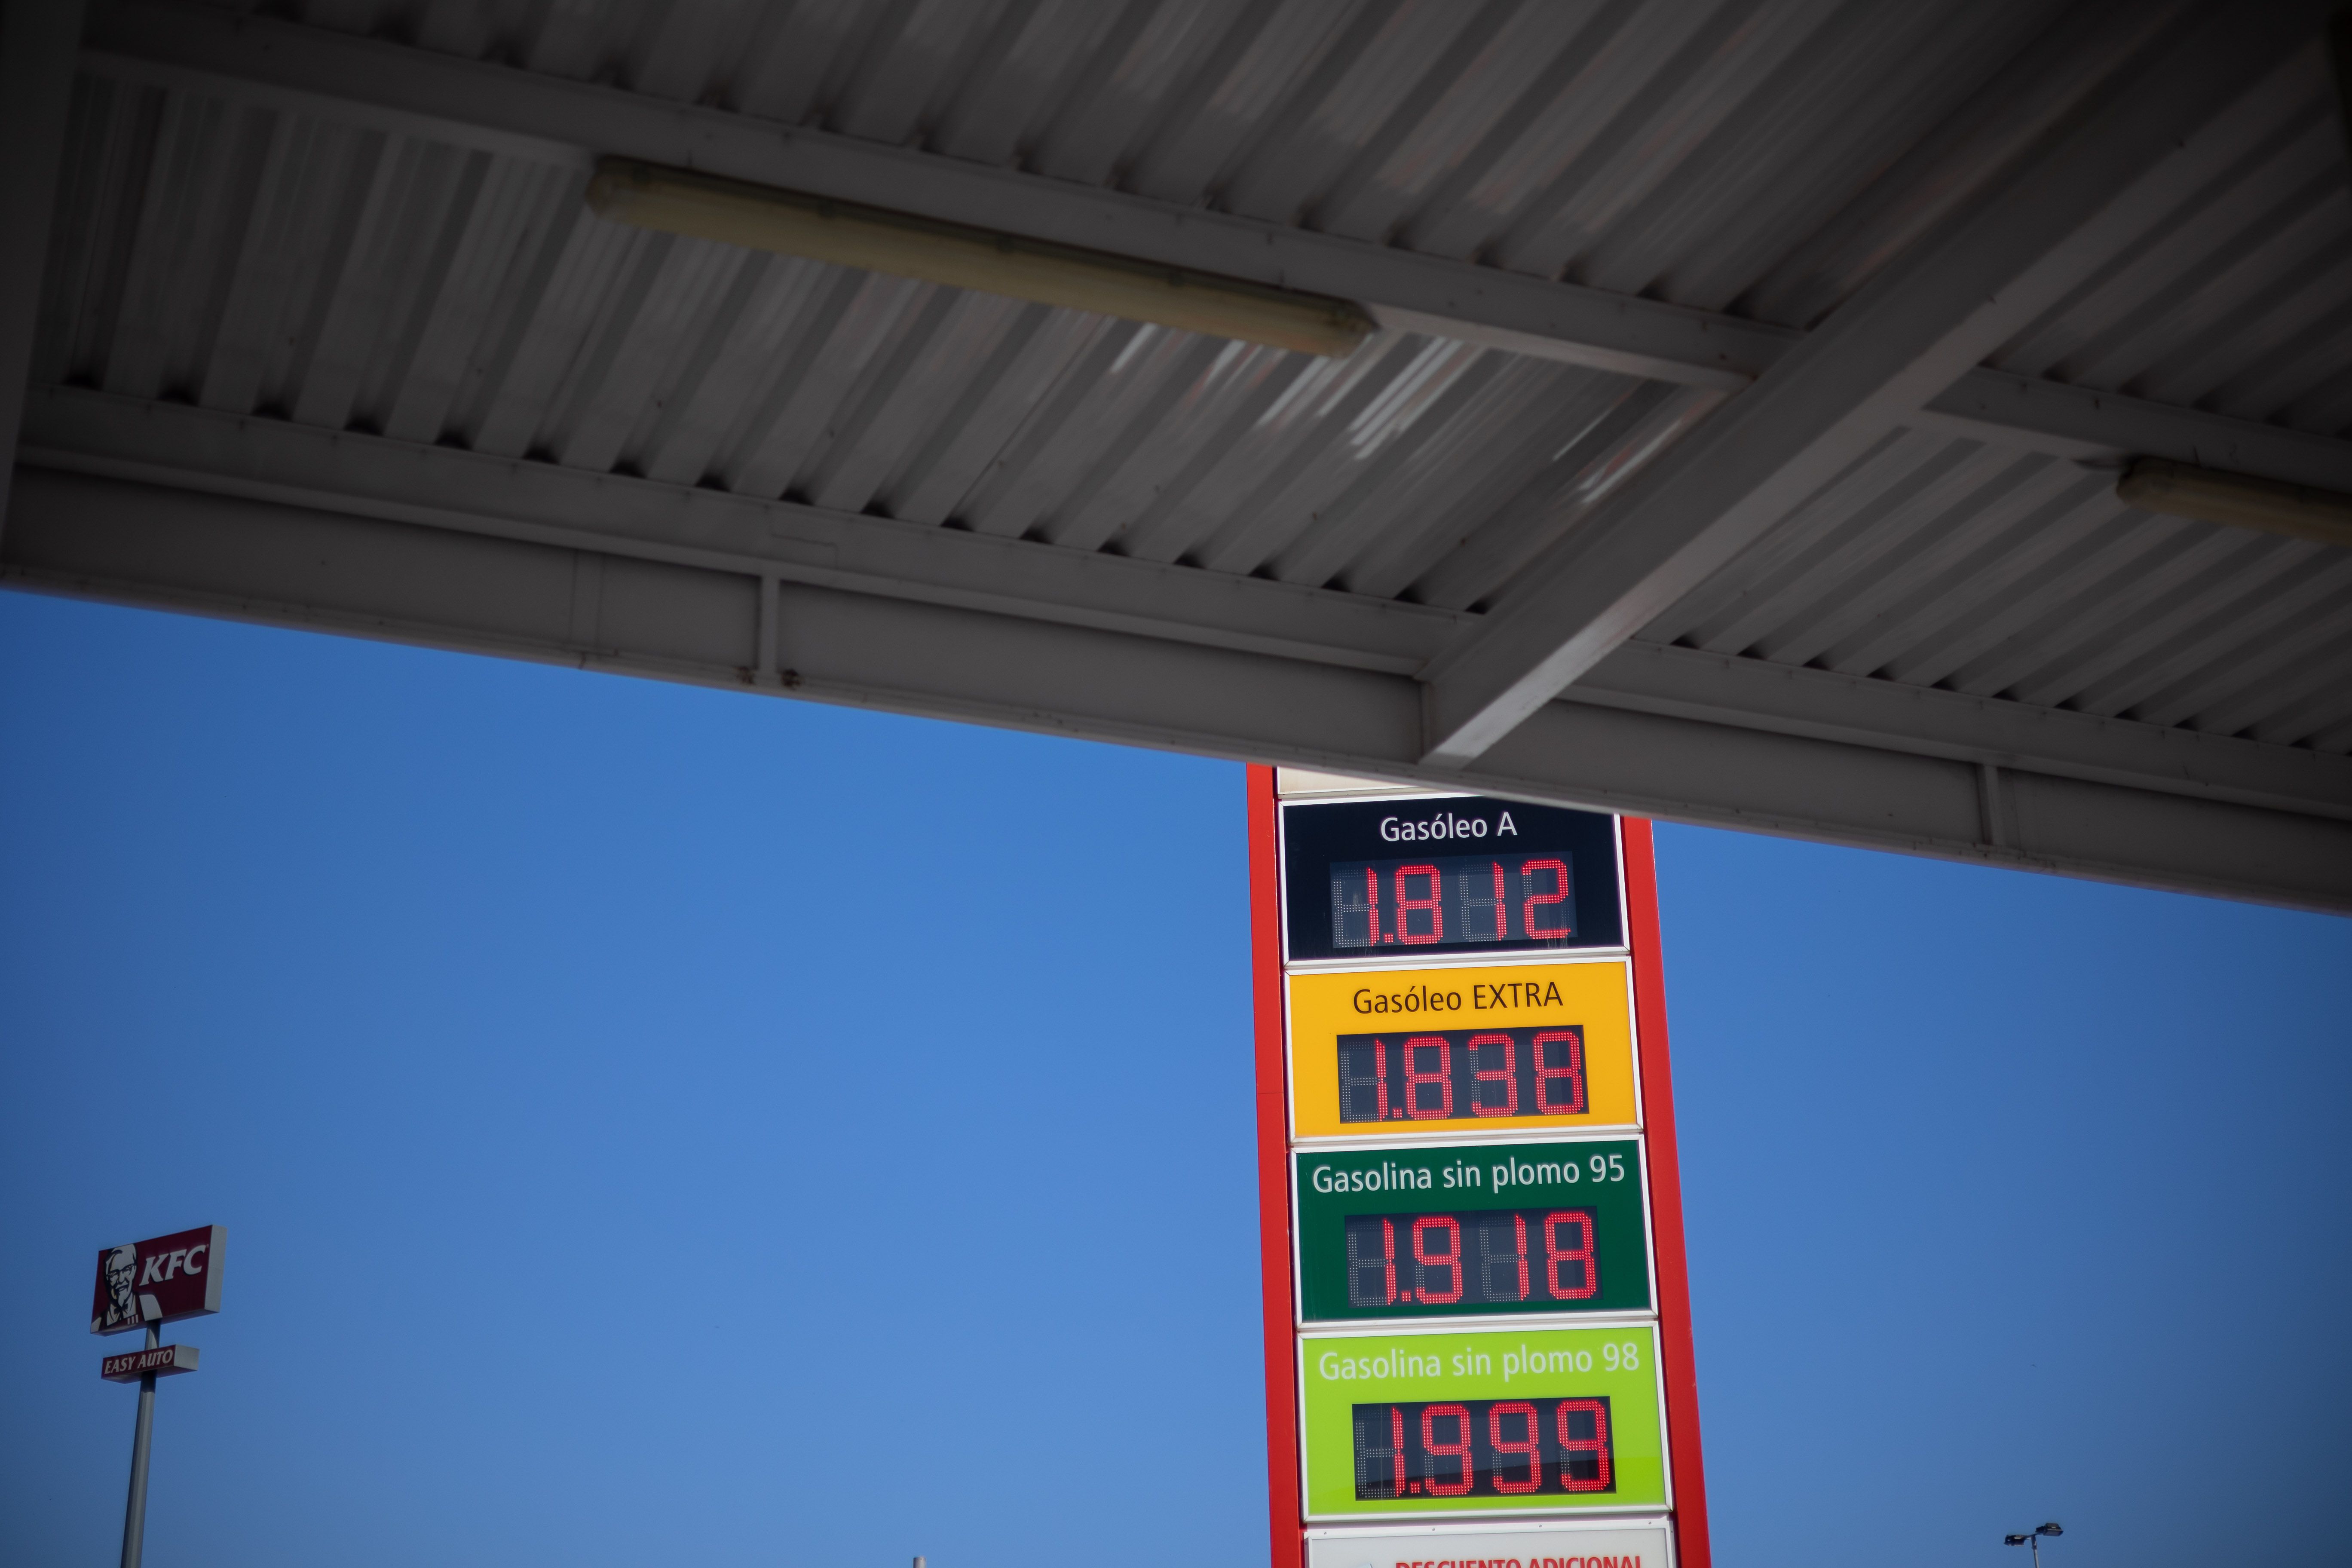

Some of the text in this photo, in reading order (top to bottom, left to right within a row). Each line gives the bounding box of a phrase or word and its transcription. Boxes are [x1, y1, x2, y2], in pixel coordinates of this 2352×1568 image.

[1381, 812, 1518, 842] Gasóleo A
[1367, 859, 1571, 946] 1.812
[1354, 982, 1563, 1014] Gasóleo EXTRA
[1375, 1031, 1583, 1122] 1.838
[1313, 1155, 1625, 1194] Gasolina sin plomo 95
[139, 1245, 206, 1286] KFC
[1384, 1212, 1596, 1305] 1.918
[104, 1349, 173, 1374] EASY AUTO
[1319, 1342, 1639, 1382] Gasolina sin plomo 98
[1392, 1399, 1610, 1497] 1.999
